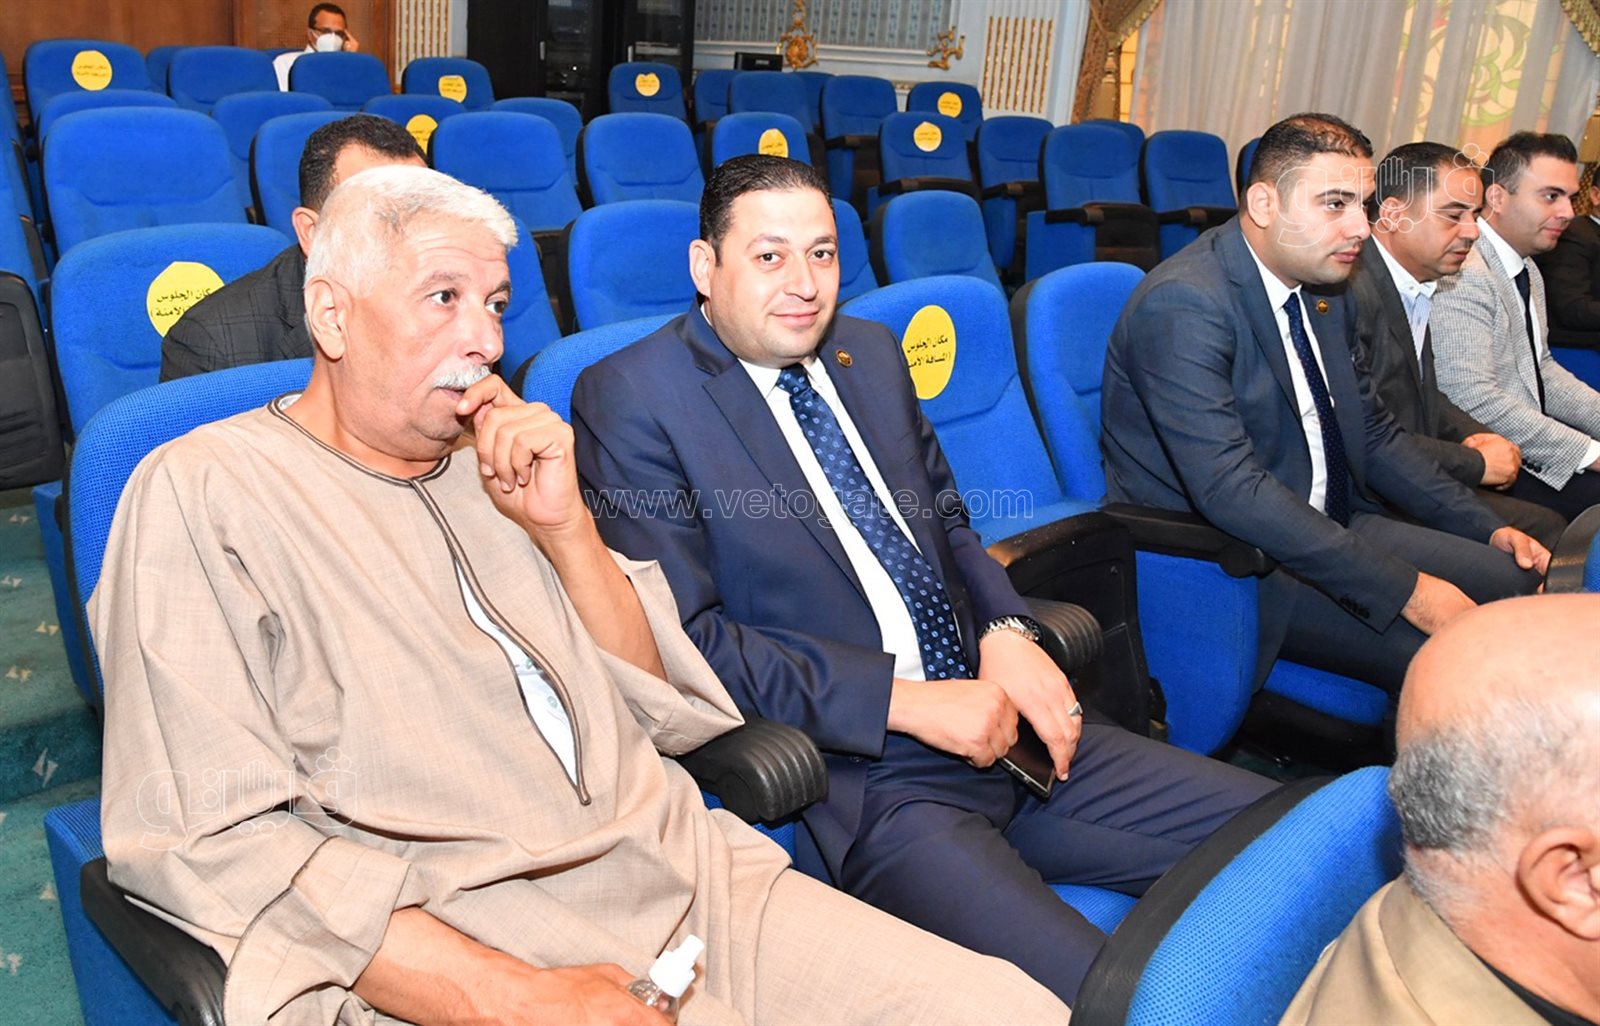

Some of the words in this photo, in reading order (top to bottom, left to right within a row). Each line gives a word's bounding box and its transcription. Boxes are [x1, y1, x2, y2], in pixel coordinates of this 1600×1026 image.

[156, 290, 194, 303] الجلوس
[195, 288, 211, 300] كان
[907, 338, 932, 353] الجلوس
[932, 335, 948, 348] مكان
